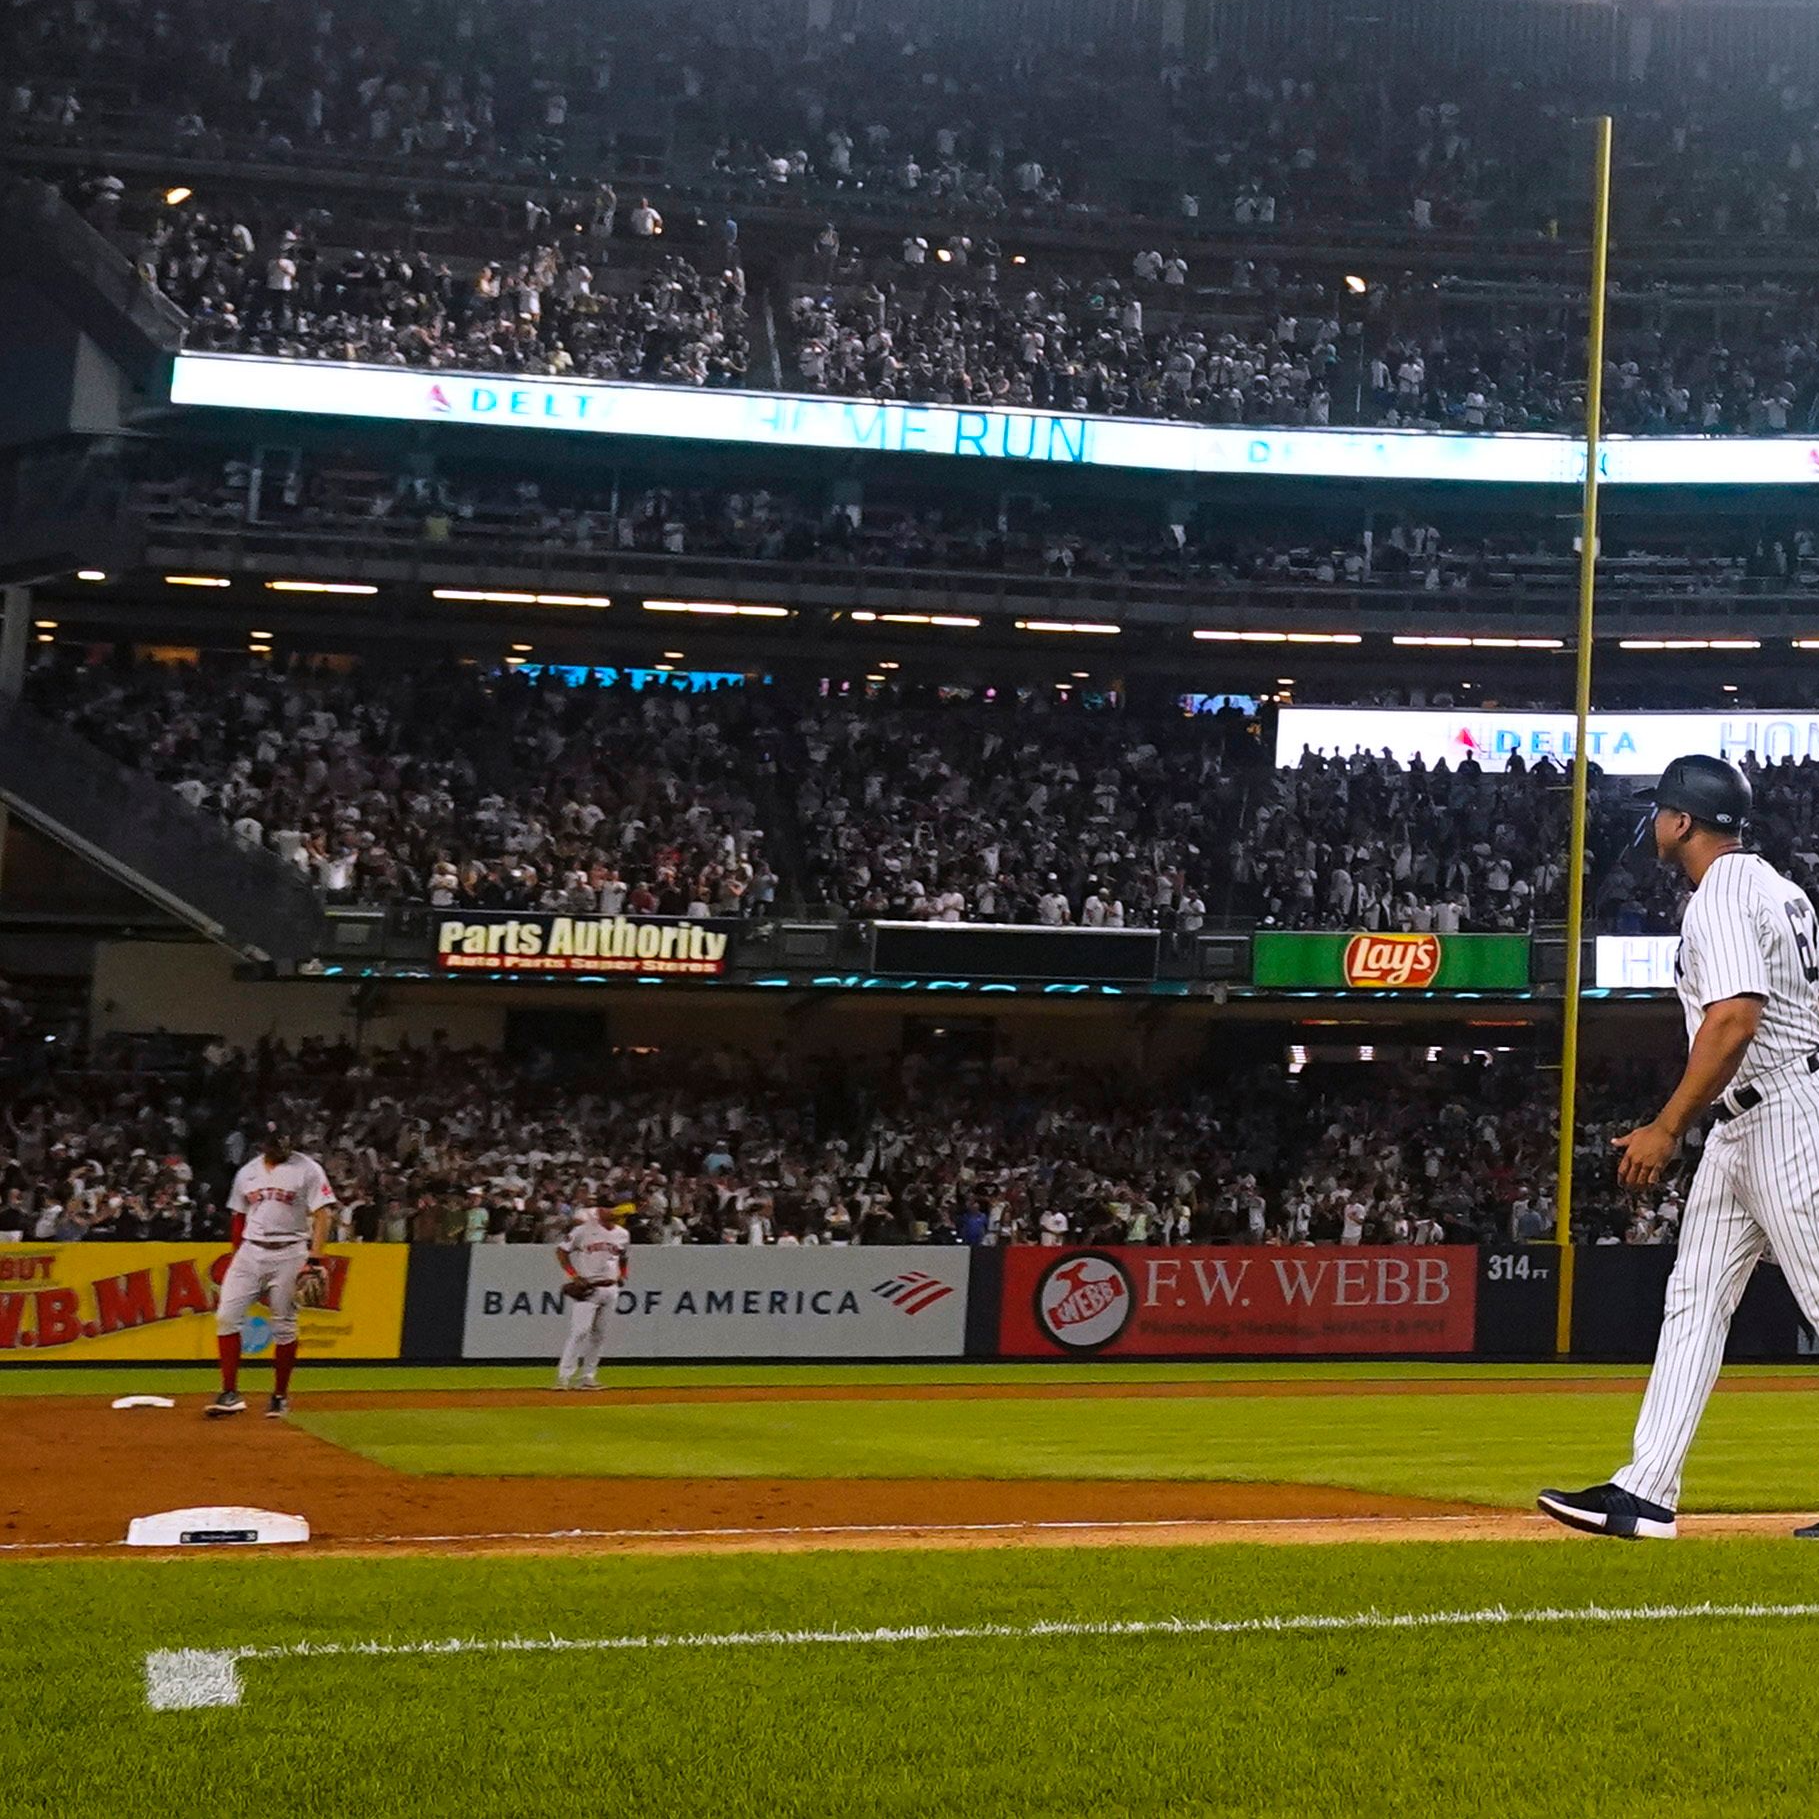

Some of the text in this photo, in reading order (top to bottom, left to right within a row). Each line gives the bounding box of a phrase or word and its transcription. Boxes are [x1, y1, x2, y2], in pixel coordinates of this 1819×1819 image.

[471, 388, 618, 420] DELT
[956, 412, 1087, 464] RUN
[1496, 730, 1636, 756] DELTA
[439, 916, 727, 961] Parts Authority
[1351, 937, 1434, 985] Lay's
[0, 1256, 56, 1281] BUT
[1144, 1259, 1451, 1307] F.W. WEBB
[1487, 1255, 1549, 1280] 314 FT
[483, 1291, 564, 1315] BAN
[674, 1291, 860, 1315] AMERICA
[1057, 1281, 1114, 1322] WEBB
